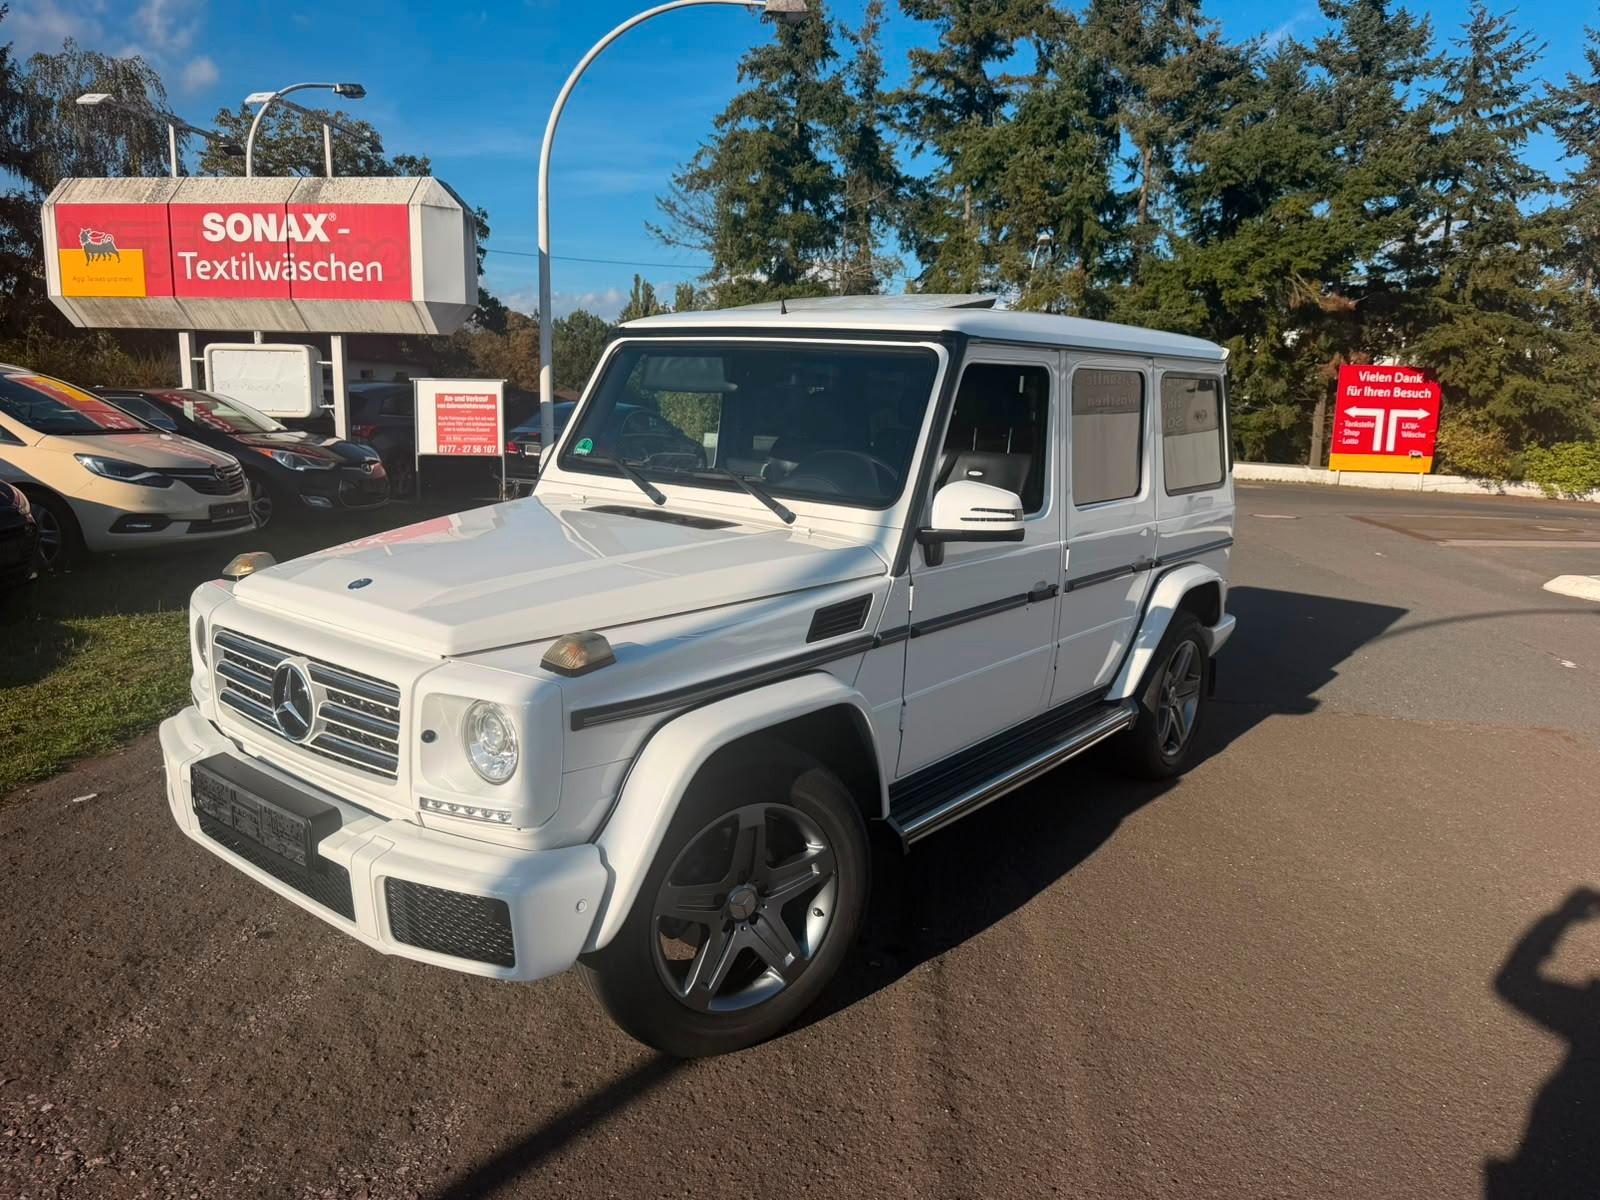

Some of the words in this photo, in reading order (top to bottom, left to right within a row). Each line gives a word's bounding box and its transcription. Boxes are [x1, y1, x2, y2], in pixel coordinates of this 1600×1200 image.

[177, 251, 383, 282] Textilwäschen
[1359, 371, 1392, 383] Vielen
[1394, 372, 1423, 383] Dank
[1346, 385, 1362, 397] für
[1364, 386, 1390, 397] Ihren
[1393, 387, 1431, 398] Besuch
[439, 445, 456, 453] 0177
[463, 445, 471, 453] 27
[473, 445, 482, 453] 56
[483, 445, 496, 453] 107
